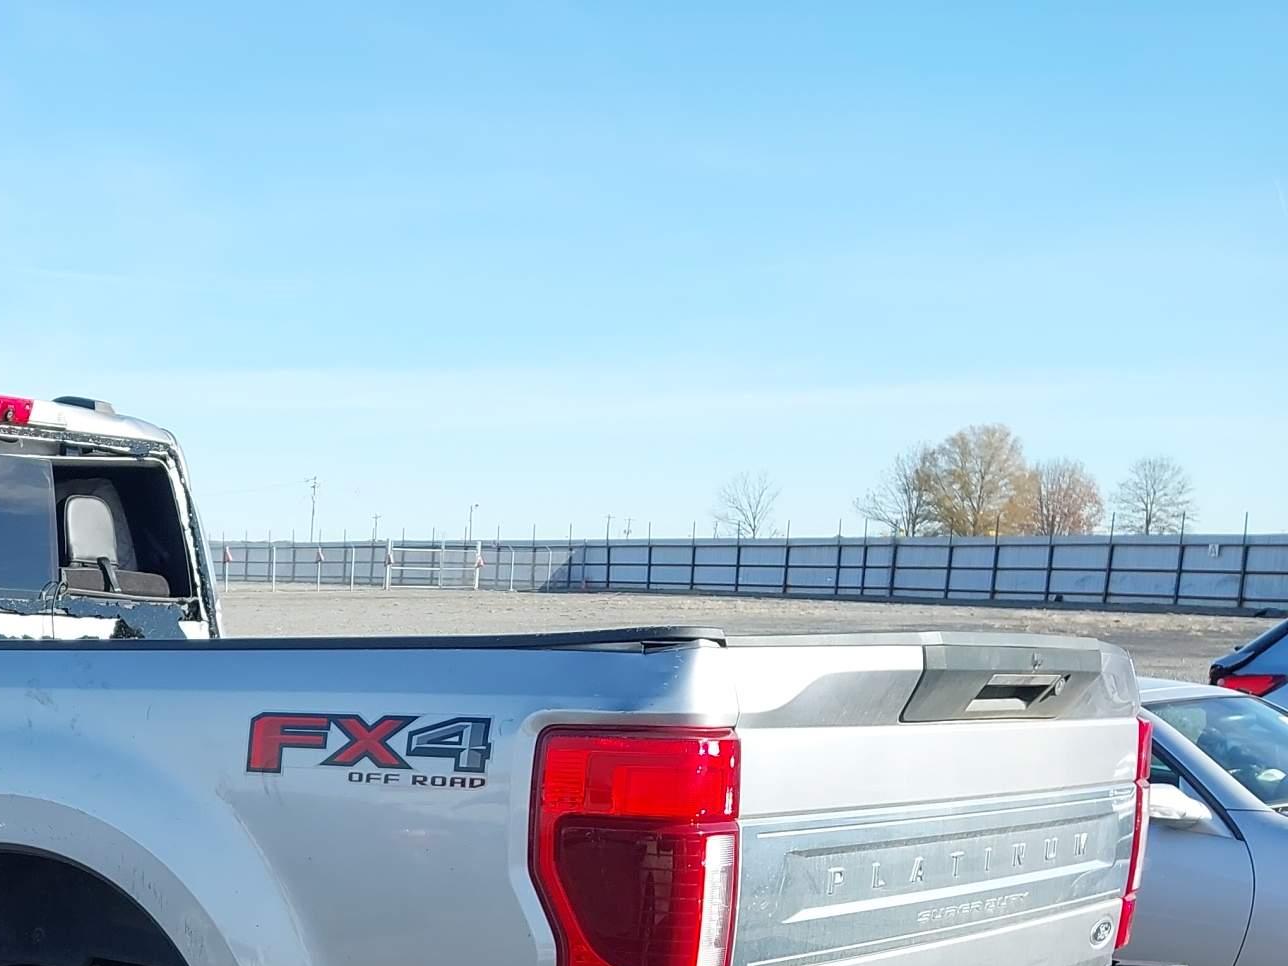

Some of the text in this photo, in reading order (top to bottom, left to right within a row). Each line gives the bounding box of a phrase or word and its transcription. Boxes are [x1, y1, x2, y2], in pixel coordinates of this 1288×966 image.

[246, 712, 491, 773] FX4
[348, 772, 486, 788] OFF ROAD
[826, 832, 1090, 896] PLATINUM
[916, 891, 1030, 922] SUPER DUTY
